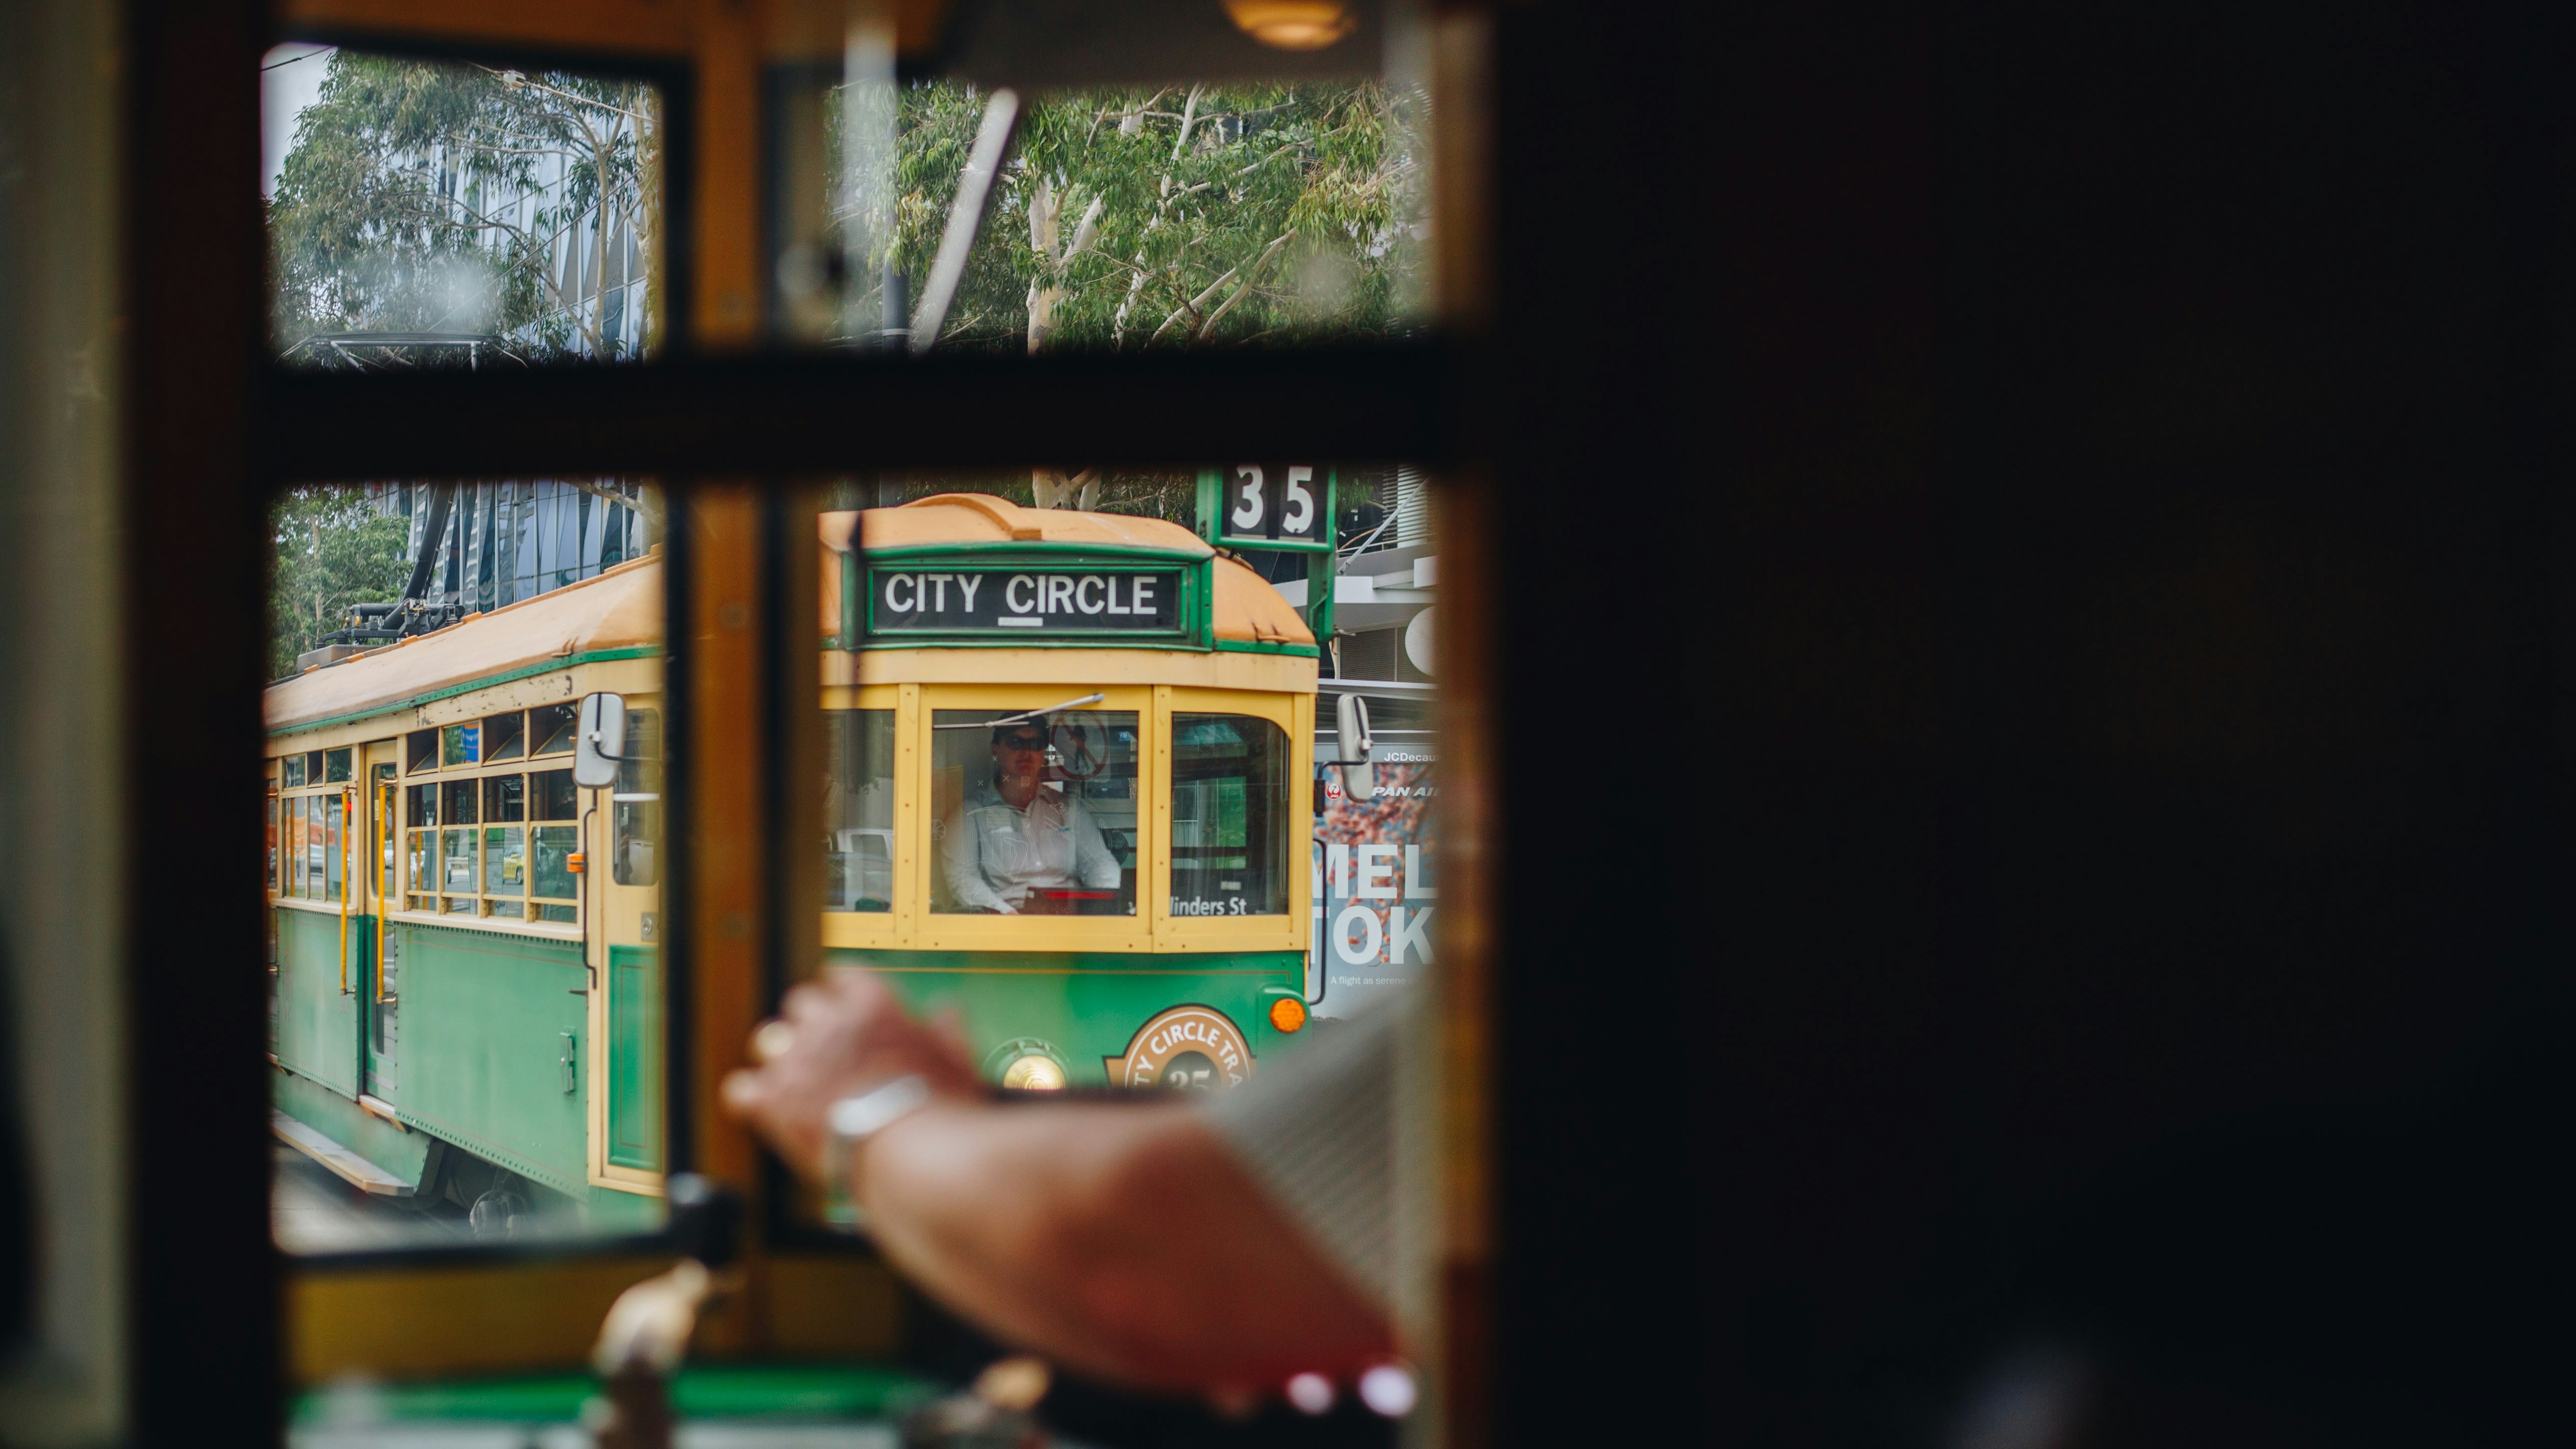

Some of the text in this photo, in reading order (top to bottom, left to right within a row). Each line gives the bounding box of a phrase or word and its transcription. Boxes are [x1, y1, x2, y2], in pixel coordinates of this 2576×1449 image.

[1231, 464, 1313, 534] 35
[885, 573, 1158, 614] CITY CIRCLE
[1383, 752, 1439, 762] JCDecau
[1229, 897, 1247, 915] St
[1339, 976, 1361, 986] flight
[1150, 1021, 1221, 1055] CIRCLE
